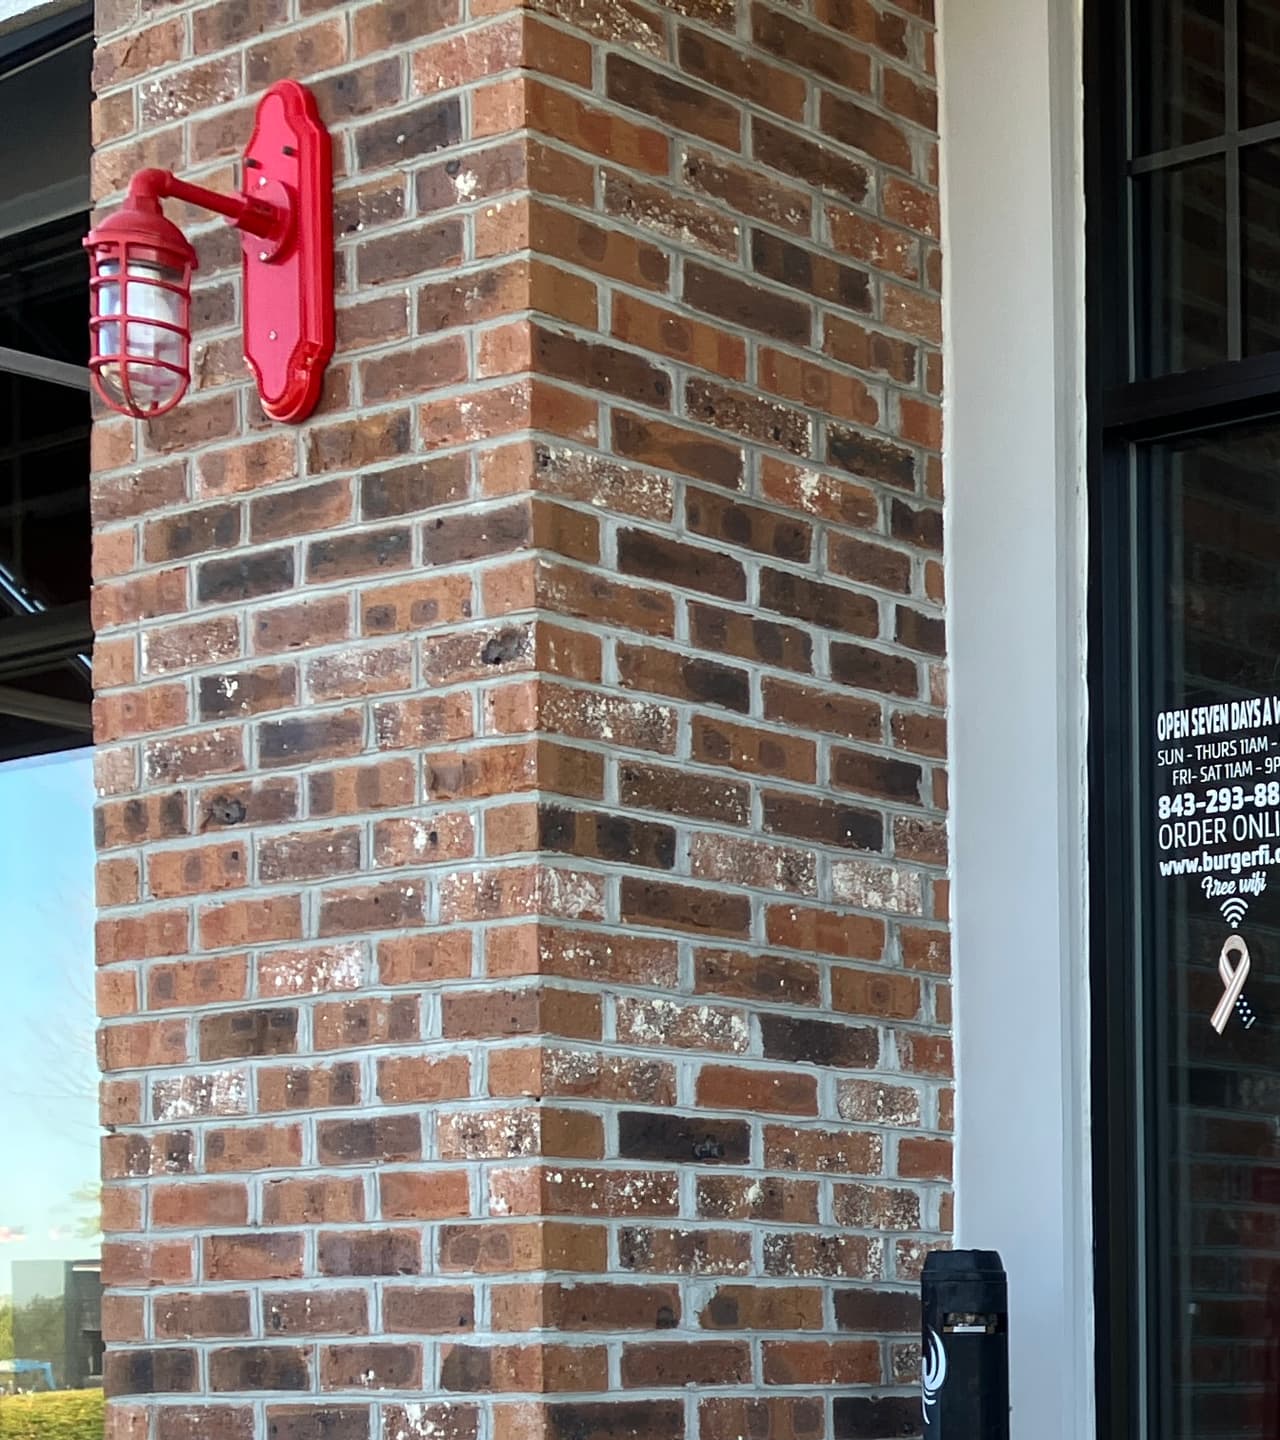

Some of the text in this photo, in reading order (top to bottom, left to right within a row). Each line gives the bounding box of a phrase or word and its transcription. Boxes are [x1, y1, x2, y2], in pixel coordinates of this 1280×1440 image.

[1157, 709, 1189, 742] OPEN
[1191, 703, 1229, 737] SEVEN
[1231, 698, 1261, 731] DAYS
[1262, 697, 1273, 726] A
[1157, 747, 1184, 766] SUN
[1194, 739, 1238, 761] THURS
[1240, 735, 1268, 755] 11AM
[1200, 763, 1222, 783] SAT
[1223, 760, 1253, 779] 11AM
[1158, 817, 1227, 850] ORDER
[1200, 871, 1267, 900] Free wifi
